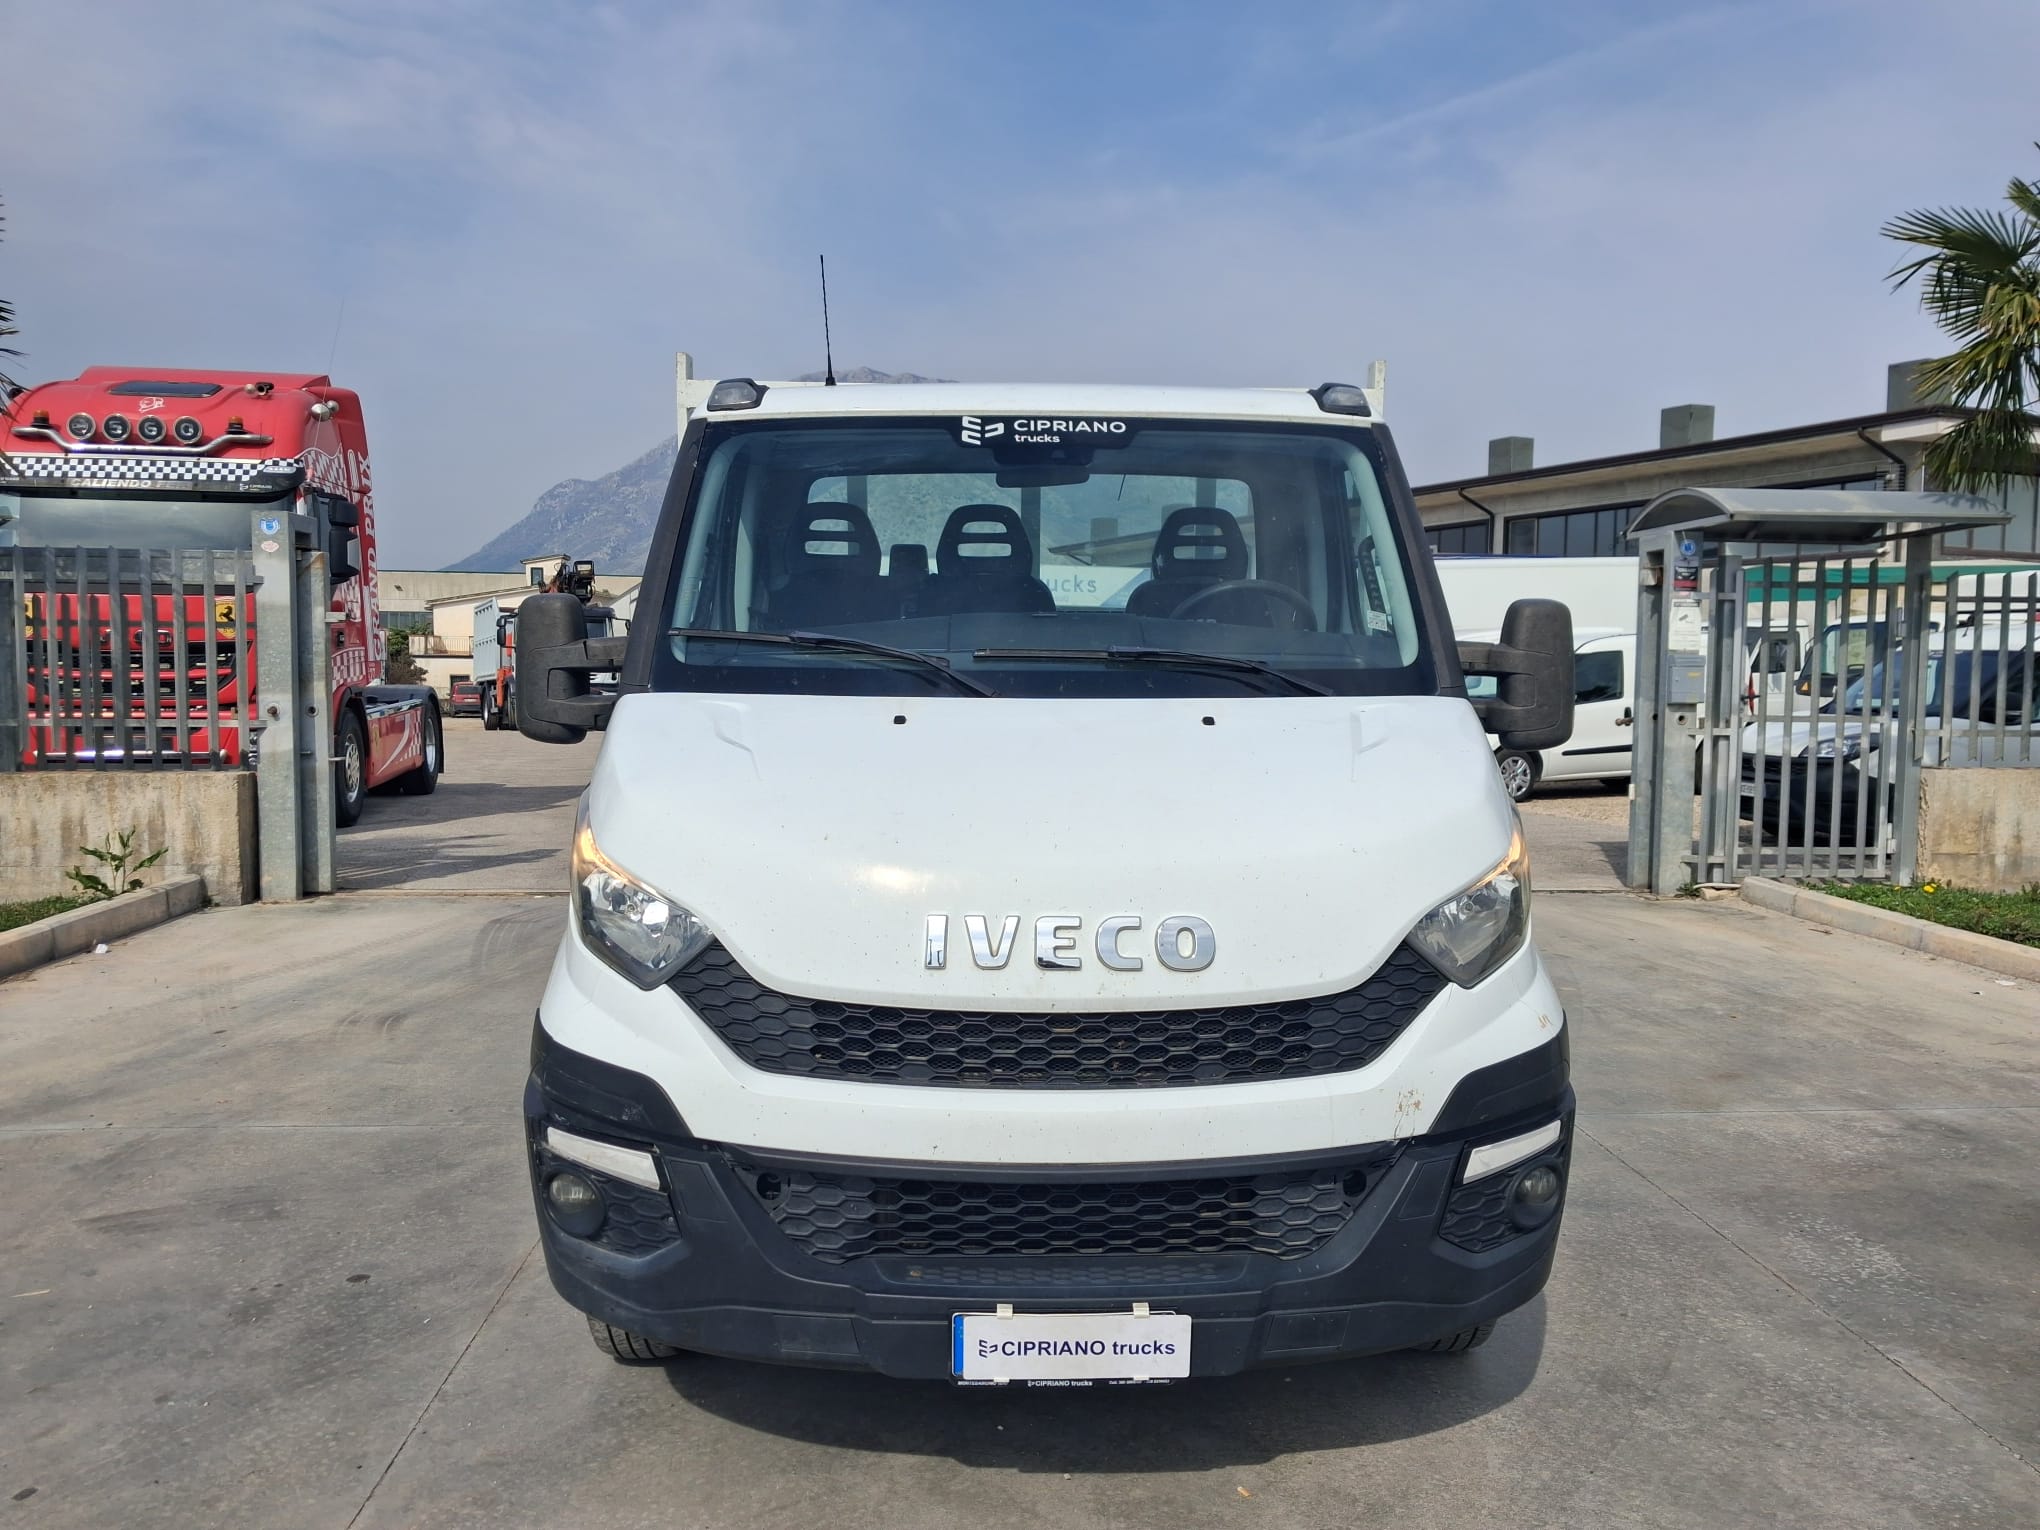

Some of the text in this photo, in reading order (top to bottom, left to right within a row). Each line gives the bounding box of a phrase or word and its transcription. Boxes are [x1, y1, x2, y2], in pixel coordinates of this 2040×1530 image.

[1013, 419, 1126, 433] CIPRIANO
[1014, 434, 1061, 443] trucks
[71, 478, 151, 488] CALIENDO
[357, 450, 376, 541] PRIX
[1046, 574, 1097, 593] ucks
[367, 547, 384, 660] GRAND
[924, 914, 1217, 972] IVECO
[1001, 1340, 1176, 1357] CIPRIANO trucks
